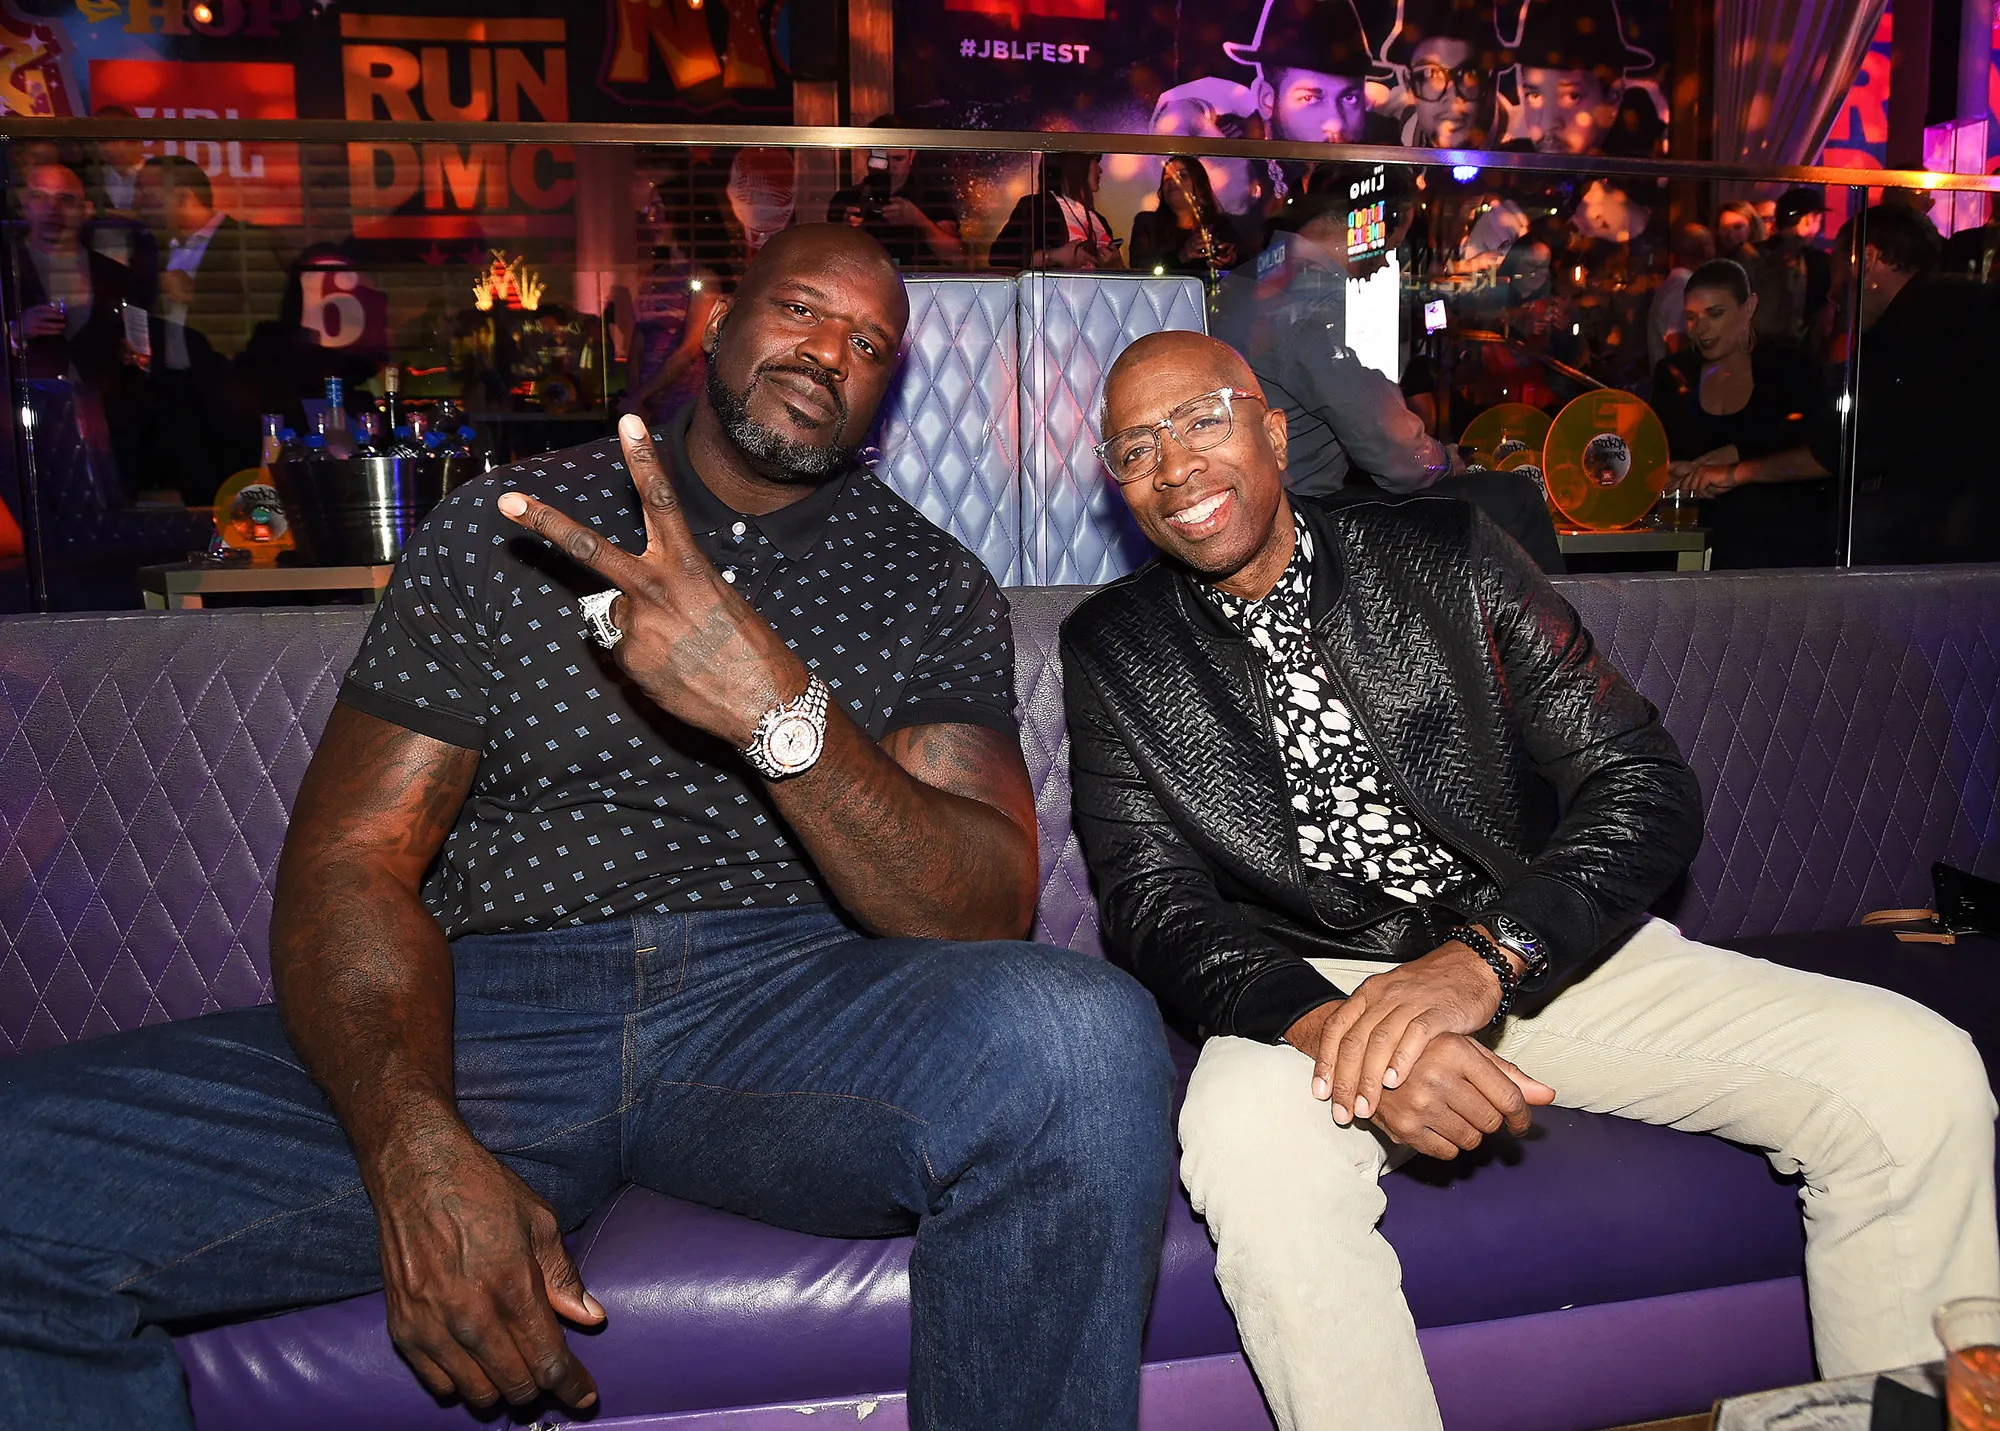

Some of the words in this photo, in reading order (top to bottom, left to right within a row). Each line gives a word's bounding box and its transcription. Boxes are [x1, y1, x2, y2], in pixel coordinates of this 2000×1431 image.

[342, 44, 570, 123] RUN
[959, 38, 1090, 64] #JBLFEST
[347, 142, 577, 209] DMC
